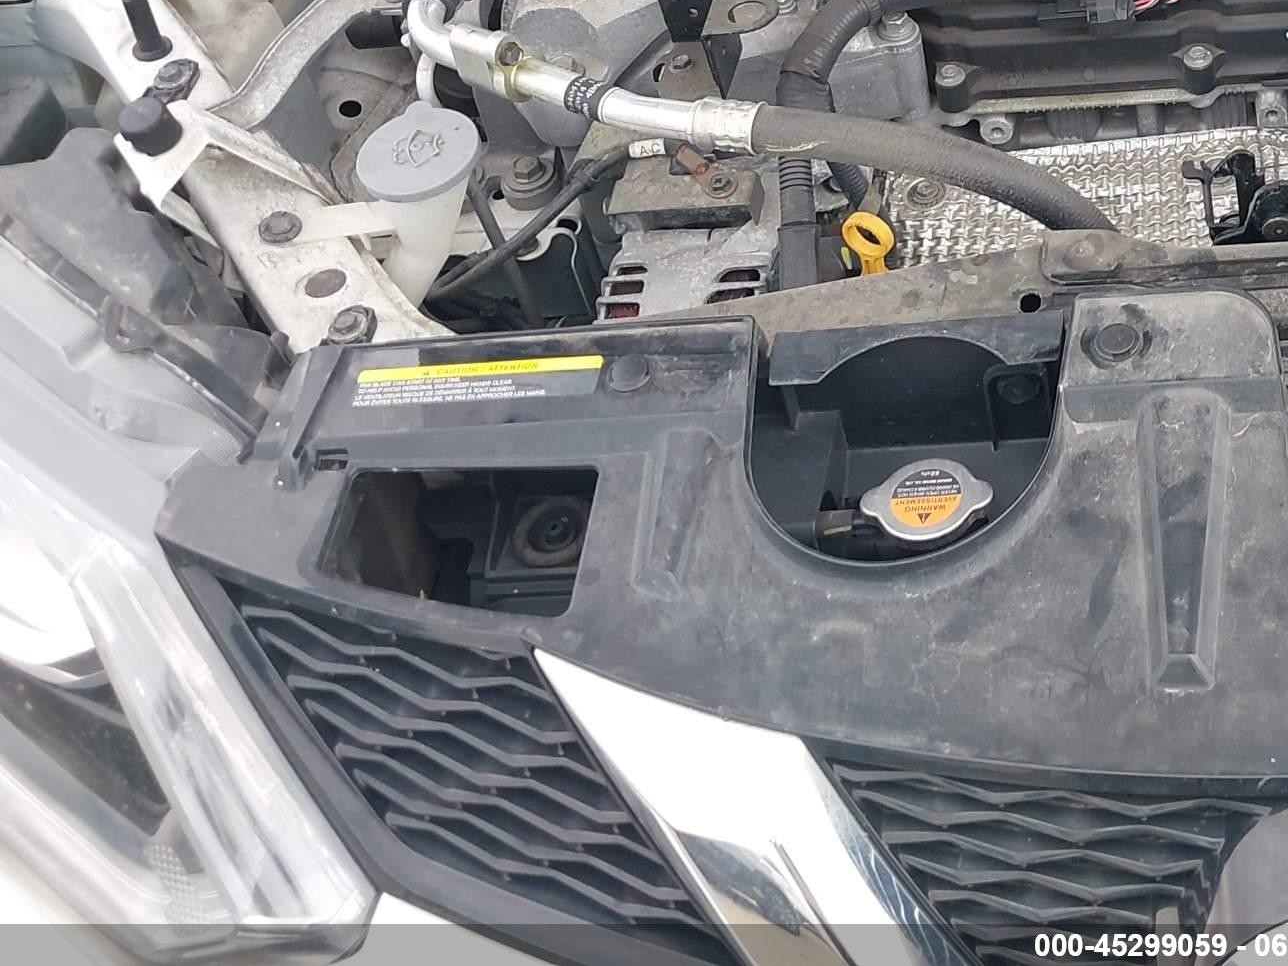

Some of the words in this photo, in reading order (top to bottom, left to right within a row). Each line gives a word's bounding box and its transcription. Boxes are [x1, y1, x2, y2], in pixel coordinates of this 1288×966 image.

[437, 365, 478, 375] CAUTION
[487, 362, 538, 372] ATTENTION
[895, 496, 956, 505] AVERTISSEMENT
[904, 504, 946, 512] WARNING
